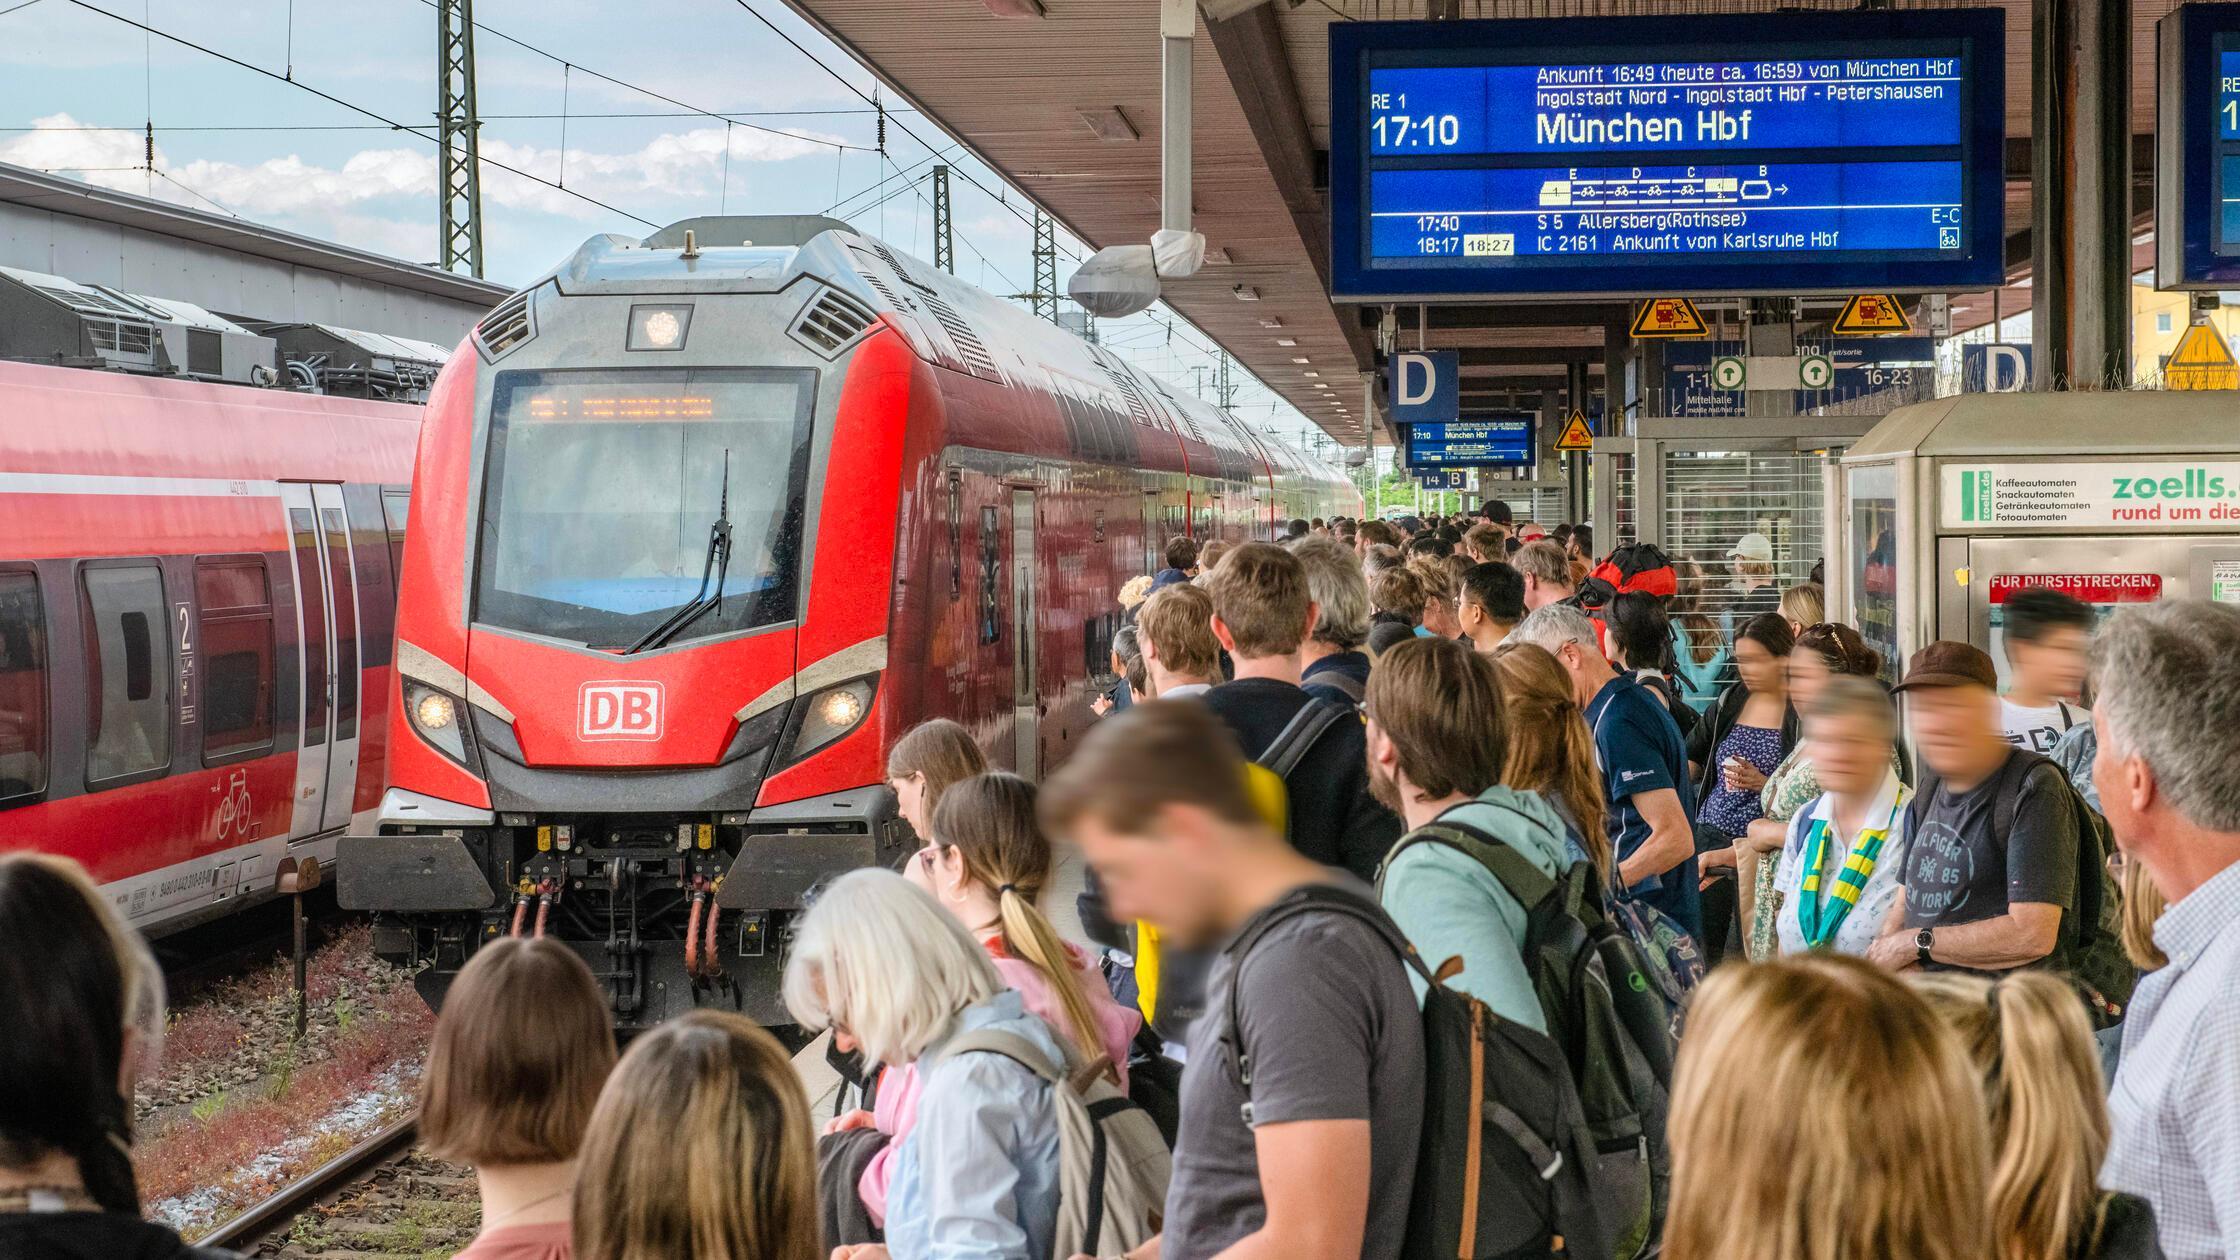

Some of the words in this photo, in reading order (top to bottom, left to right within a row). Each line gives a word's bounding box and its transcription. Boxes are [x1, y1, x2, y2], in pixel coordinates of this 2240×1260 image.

[1537, 66, 1604, 84] Ankunft
[1612, 66, 1654, 82] 16:49
[1661, 64, 1714, 81] (heute
[1721, 66, 1746, 80] ca.
[1754, 63, 1802, 80] 16:59)
[1809, 65, 1839, 79] von
[1847, 60, 1919, 77] München
[1926, 60, 1953, 76] Hbf
[1371, 94, 1390, 109] RE
[1398, 94, 1406, 109] 1
[1537, 89, 1622, 108] Ingolstadt
[1629, 89, 1667, 104] Nord
[1686, 87, 1773, 106] Ingolstadt
[1779, 86, 1807, 102] Hbf
[1827, 84, 1943, 101] Petershausen
[2222, 100, 2237, 130] 1
[1371, 115, 1459, 147] 17:10
[1537, 111, 1683, 144] München
[1697, 110, 1752, 142] Hbf
[1569, 168, 1577, 180] E
[1632, 168, 1641, 179] D
[1687, 167, 1695, 178] C
[1759, 165, 1768, 176] B
[1417, 215, 1459, 232] 17:40
[1537, 215, 1547, 230] S
[1553, 214, 1563, 230] 5
[1578, 212, 1747, 231] Allersberg(Rothsee)
[1932, 208, 1960, 223] E-C
[1417, 237, 1459, 253] 18:17
[1467, 239, 1510, 252] 18:27
[1538, 236, 1552, 251] IC
[1559, 235, 1597, 251] 2161
[1613, 233, 1679, 250] Ankunft
[1686, 236, 1717, 250] von
[1723, 232, 1805, 249] Karlsruhe
[1811, 231, 1839, 247] Hbf
[1864, 369, 1913, 386] 16-23
[1986, 346, 2026, 393] D
[1397, 354, 1436, 405] D
[1687, 372, 1713, 388] 1-1
[1413, 432, 1431, 440] 17:10
[1445, 431, 1475, 440] München
[1426, 475, 1440, 486] 14
[1451, 472, 1461, 485] B
[1995, 478, 2077, 488] Kaffeeautomaten
[2112, 468, 2238, 499] zoells.
[1981, 471, 1990, 520] zoells.de
[1995, 490, 2075, 499] Snackautomaten
[1995, 500, 2091, 510] Getränkeautomaten
[2112, 502, 2162, 520] rund
[2169, 507, 2201, 520] um
[2208, 502, 2240, 520] die
[1995, 512, 2067, 521] Fotoautomaten
[2024, 575, 2156, 588] DURSTSTRECKEN.
[180, 607, 191, 650] 2
[588, 690, 653, 731] DB
[1941, 866, 1960, 884] 85
[1921, 889, 1953, 908] YORK
